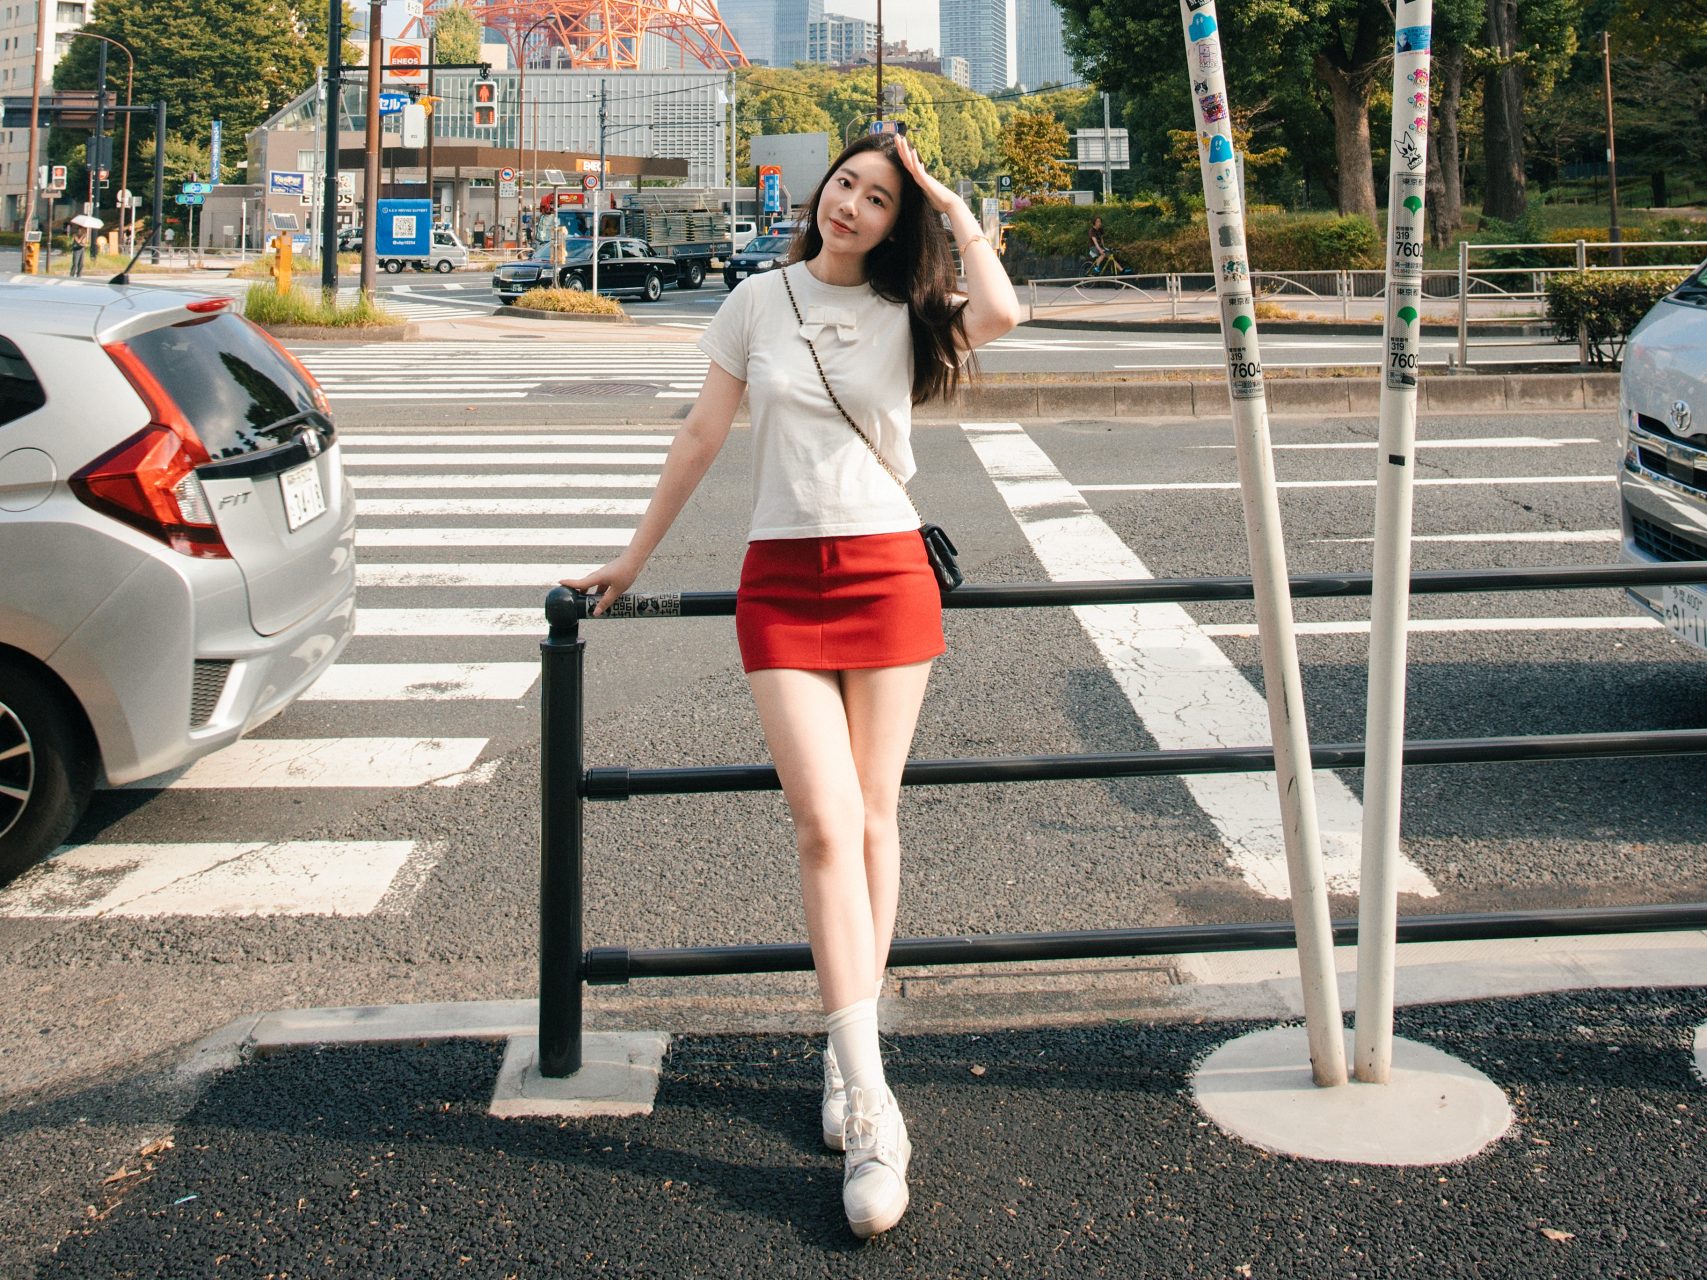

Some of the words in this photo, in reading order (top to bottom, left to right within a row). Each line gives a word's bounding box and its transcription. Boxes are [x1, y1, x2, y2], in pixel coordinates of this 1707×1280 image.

[391, 57, 419, 66] ENEOS
[1396, 231, 1410, 240] 319
[1391, 342, 1405, 351] 319
[1230, 352, 1243, 361] 319
[218, 490, 252, 510] FIT
